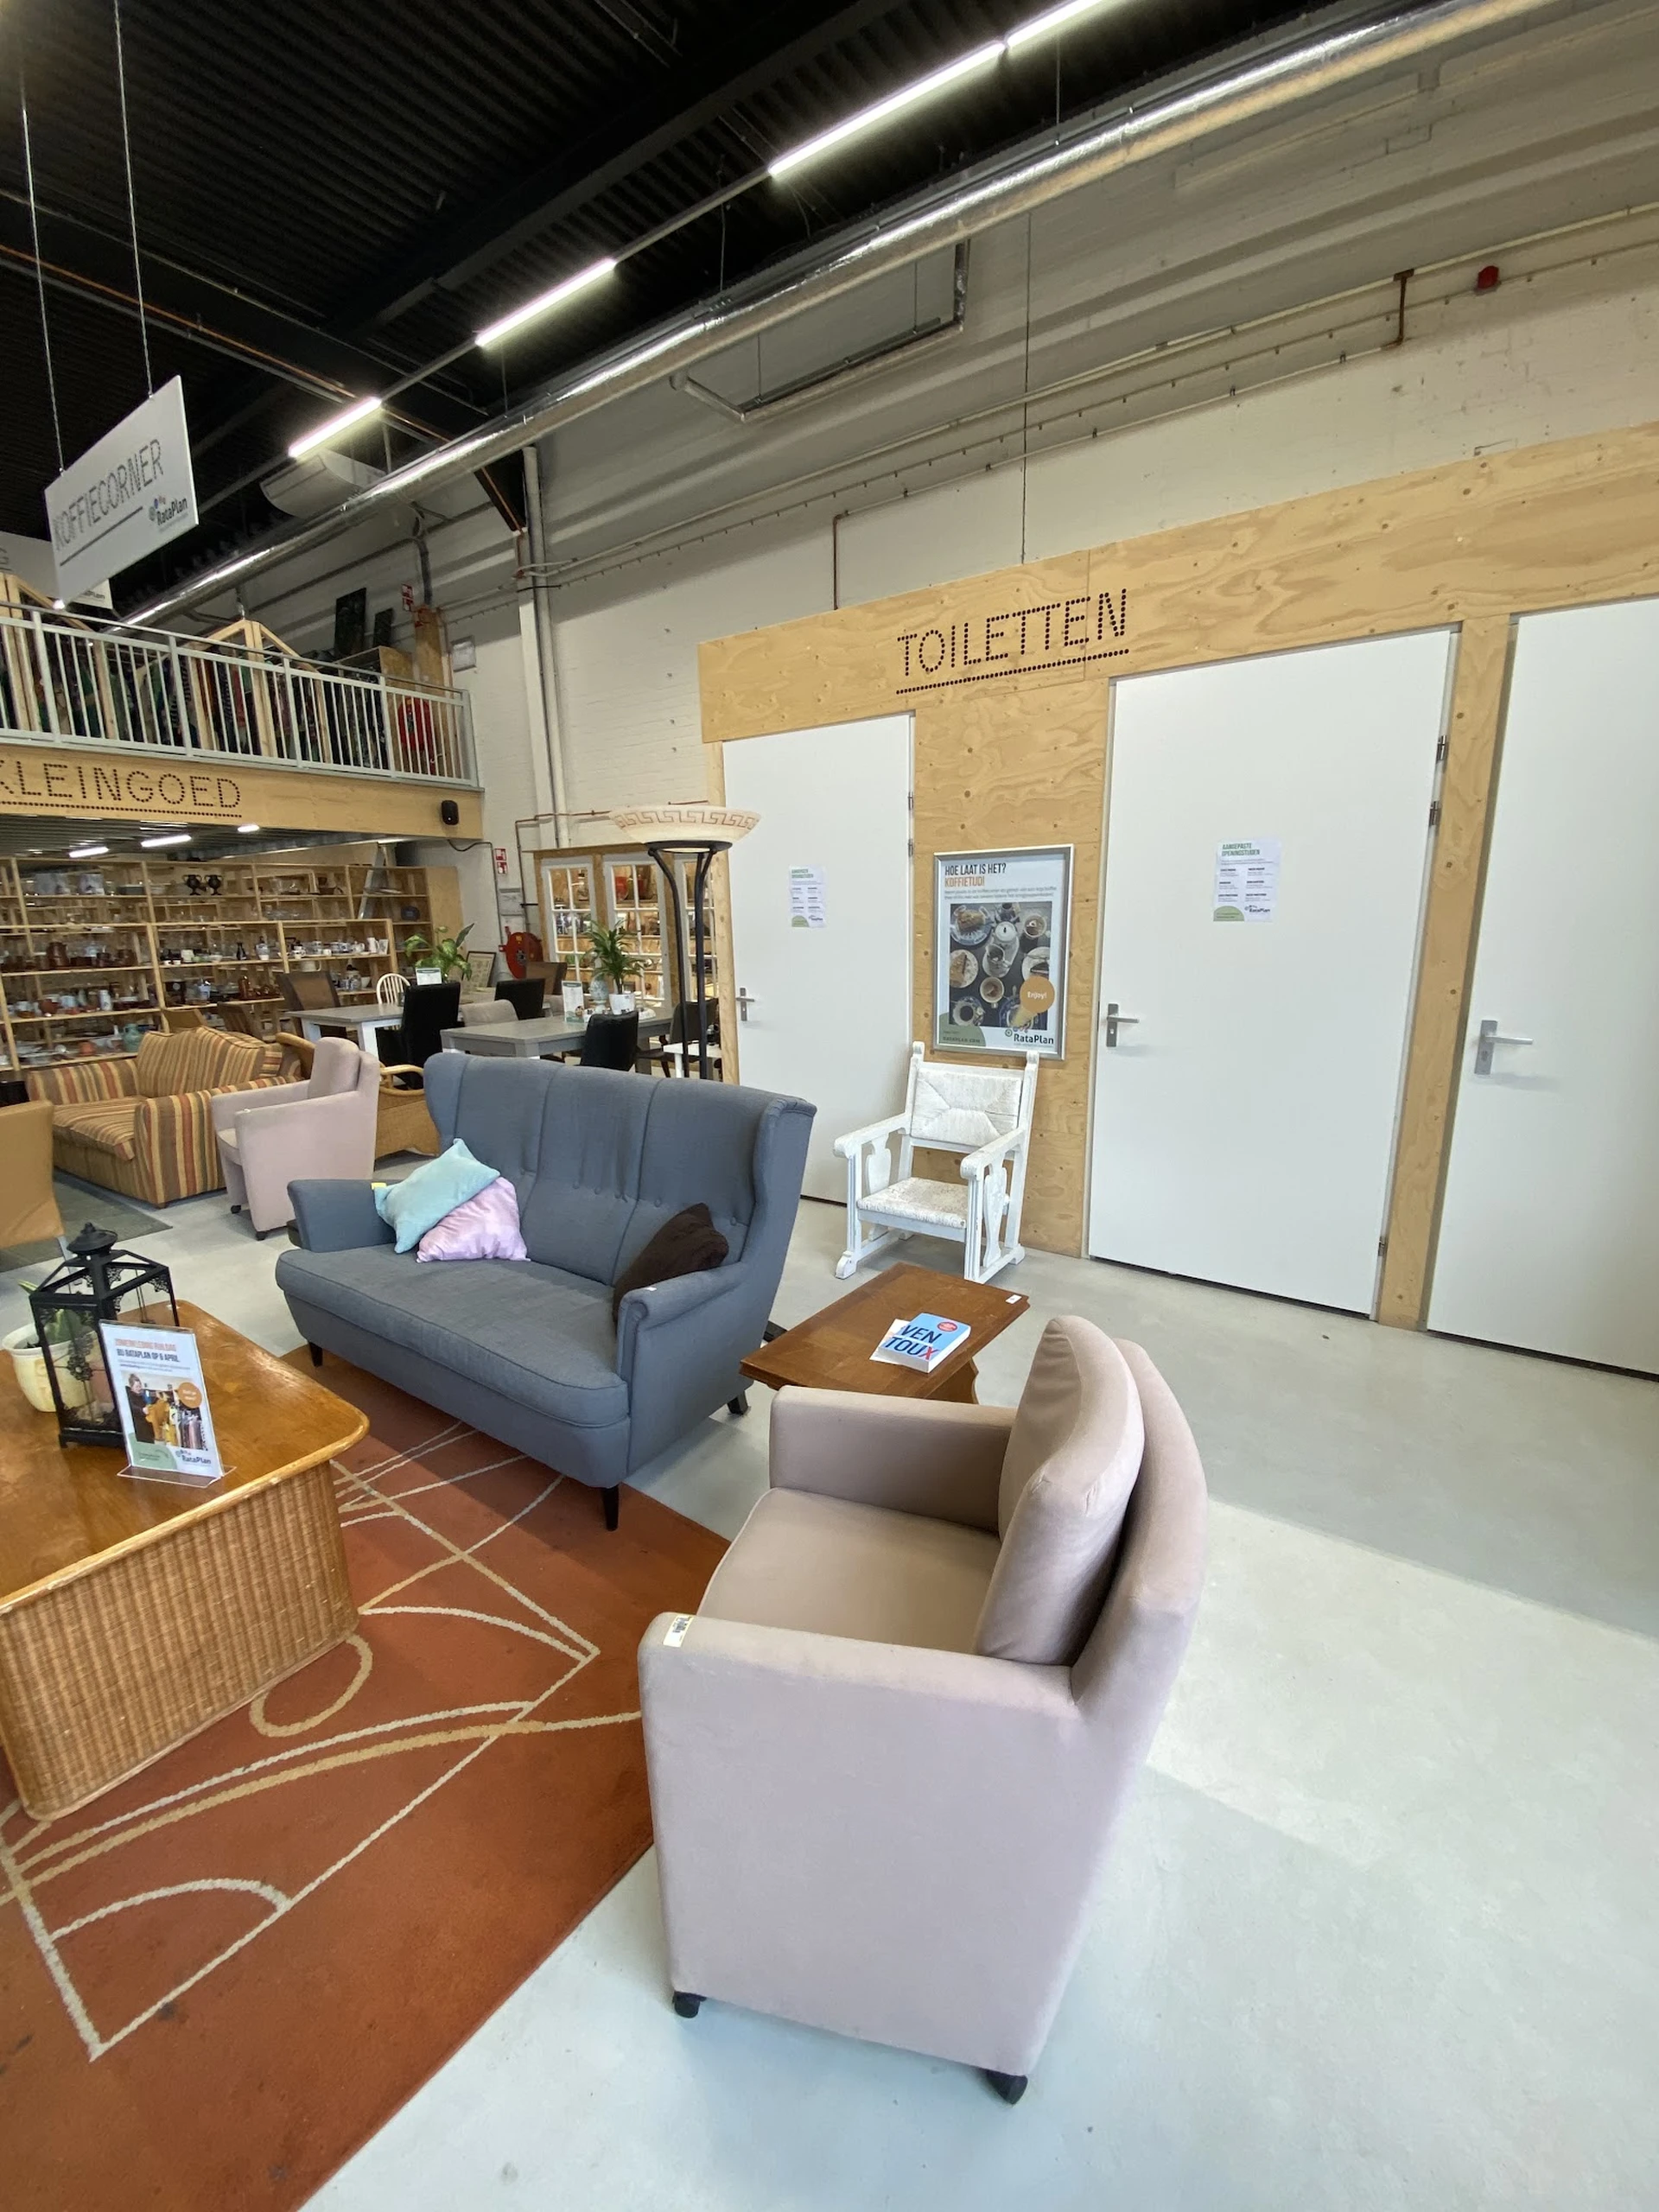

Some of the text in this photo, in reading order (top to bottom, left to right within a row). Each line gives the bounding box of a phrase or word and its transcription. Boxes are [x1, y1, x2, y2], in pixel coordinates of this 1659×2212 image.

[53, 439, 164, 551] KOFFIECORNER
[156, 498, 188, 525] RataPlan
[897, 588, 1127, 677] TOILETTEN
[944, 862, 1007, 876] HOE LAAT IS HET?
[1027, 991, 1047, 1000] Enjoy!
[1014, 1033, 1054, 1045] RataPlan
[900, 1325, 943, 1344] VEN
[124, 1349, 151, 1359] RATAPLAN
[885, 1336, 938, 1361] TOUX
[181, 1454, 212, 1465] RataPlan
